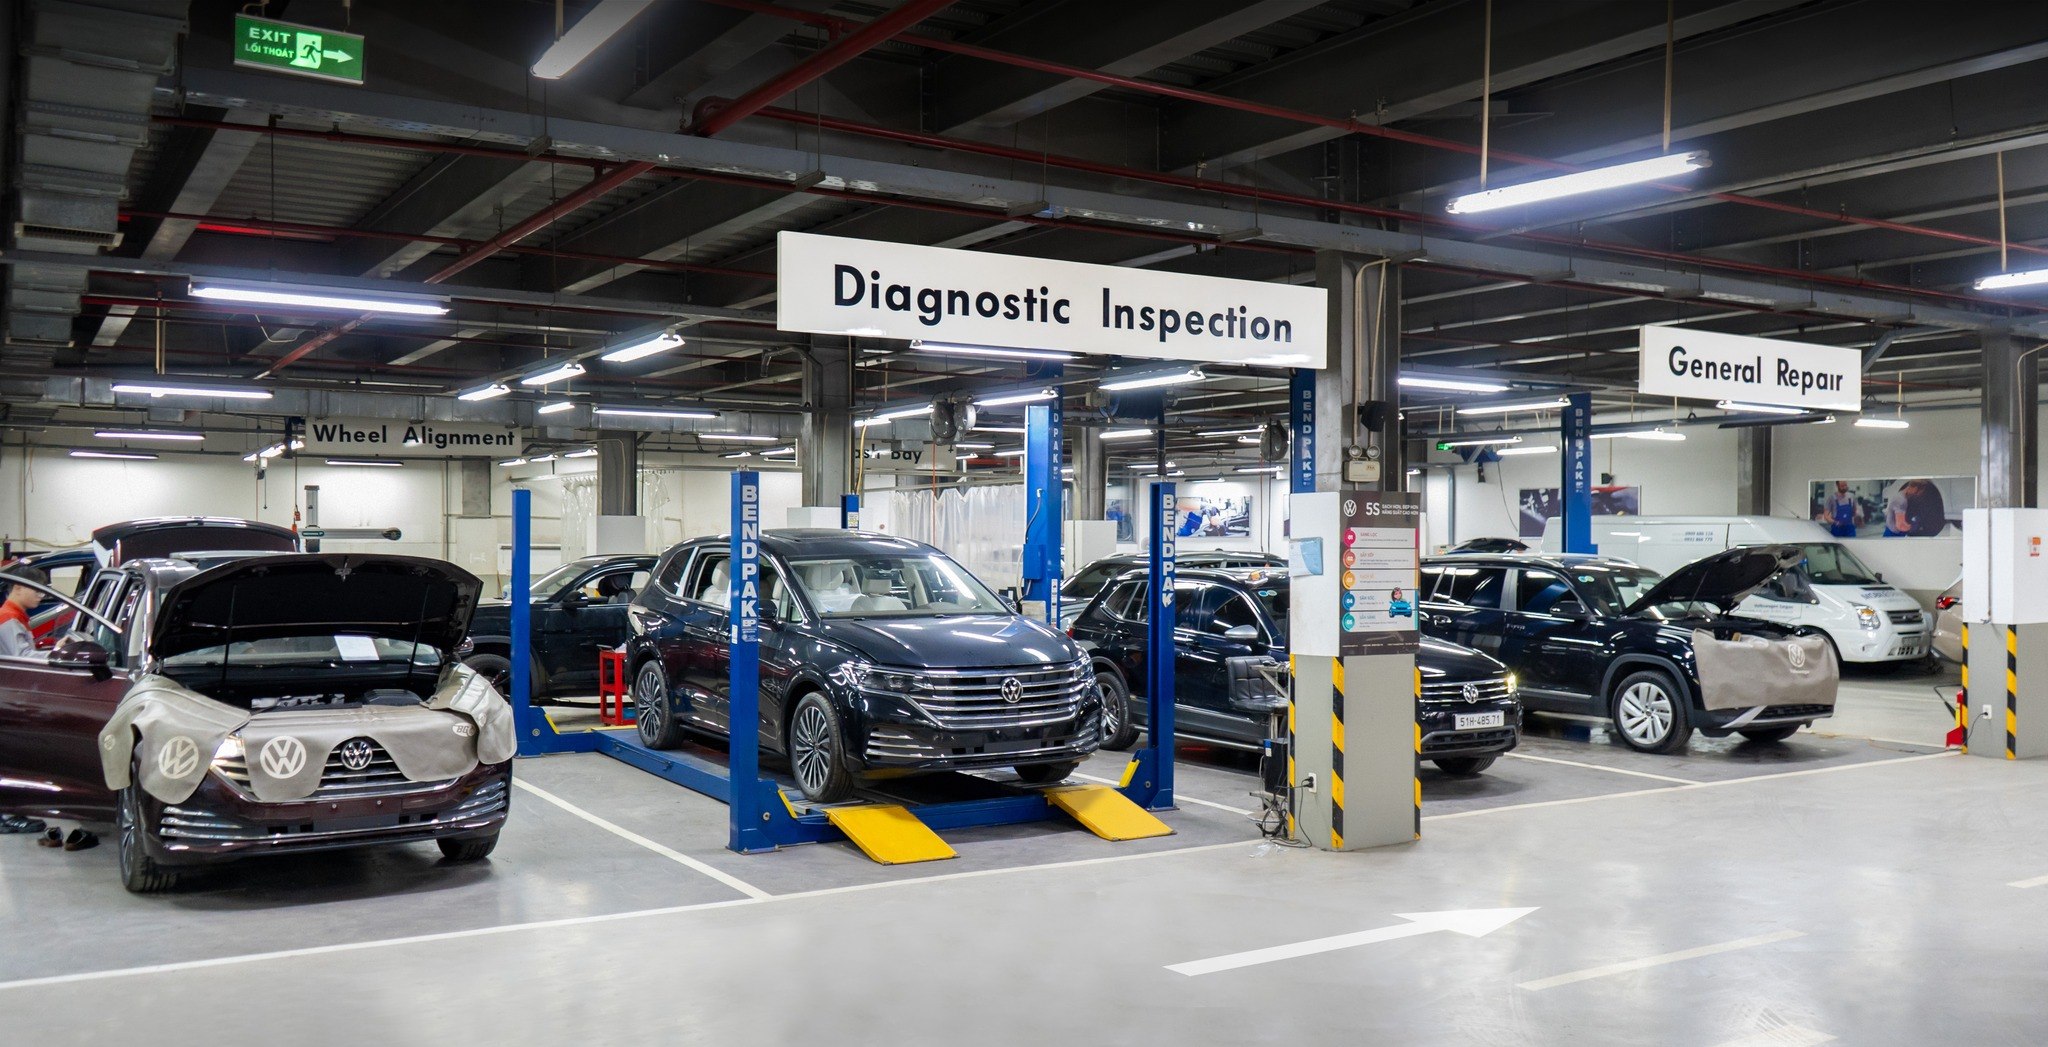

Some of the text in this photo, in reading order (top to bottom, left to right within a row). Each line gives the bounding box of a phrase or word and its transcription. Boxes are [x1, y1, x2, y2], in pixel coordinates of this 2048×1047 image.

[249, 27, 291, 44] EXIT
[264, 46, 295, 59] THOÁT
[834, 263, 1293, 343] Diagnostic Inspection
[1668, 345, 1844, 396] General Repair
[312, 424, 515, 449] Wheel Alignment
[1302, 390, 1312, 471] BENDPAK
[1575, 408, 1584, 480] BENDPAK
[855, 443, 880, 459] ash
[1366, 502, 1380, 516] 5S
[741, 484, 758, 618] BENDPAK
[1162, 494, 1175, 608] BENDPAK
[1460, 714, 1500, 727] 51H-485.71
